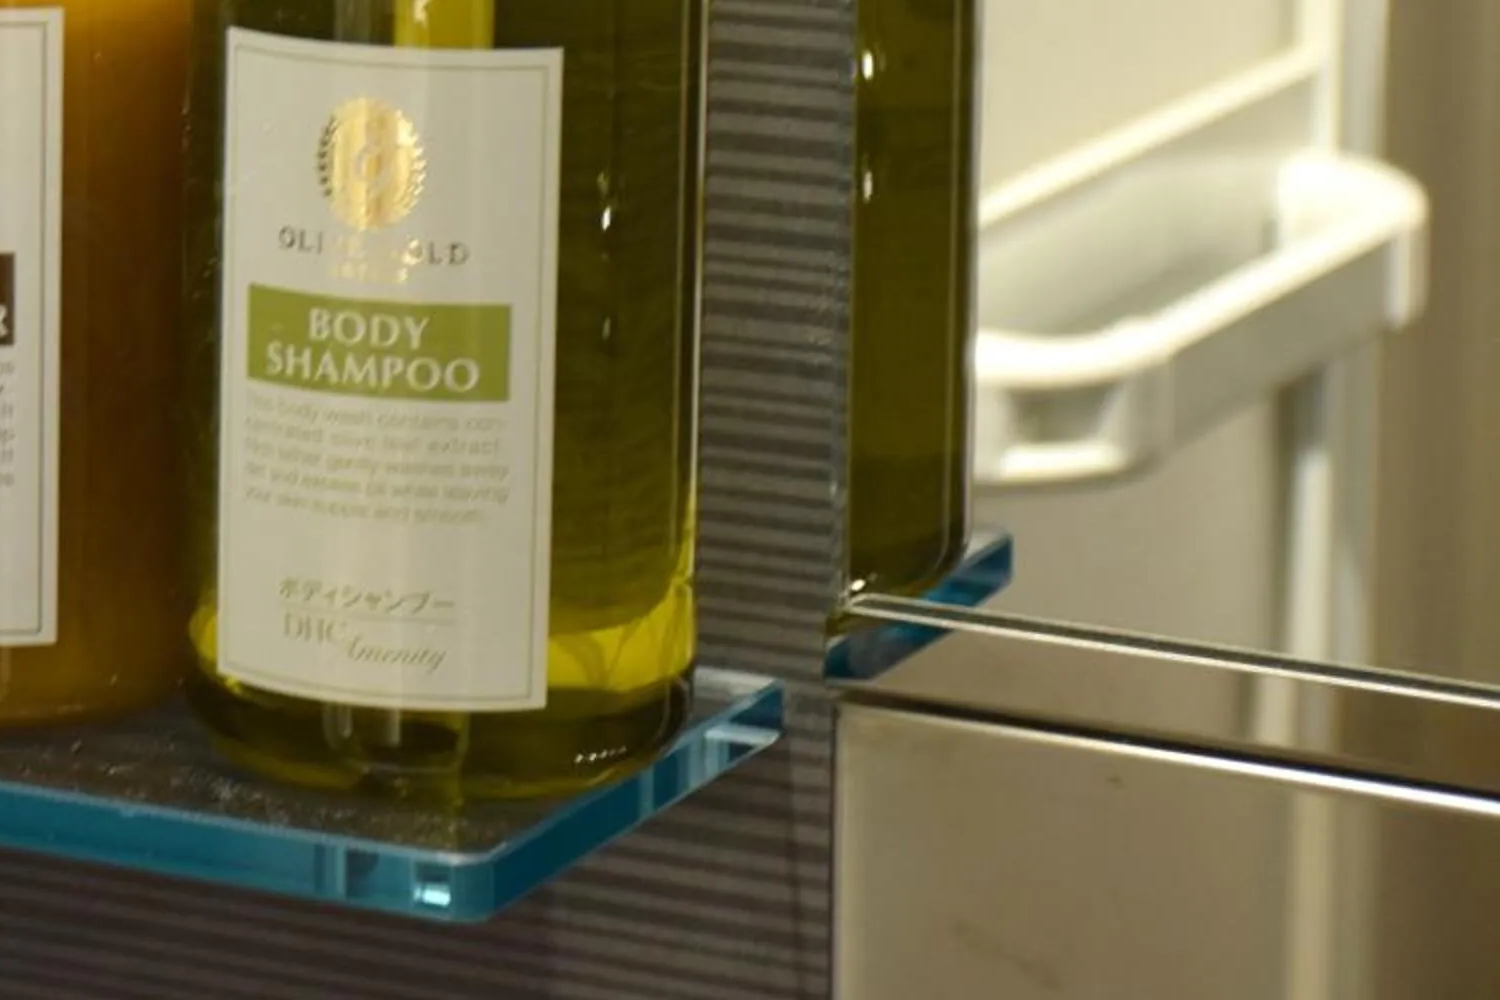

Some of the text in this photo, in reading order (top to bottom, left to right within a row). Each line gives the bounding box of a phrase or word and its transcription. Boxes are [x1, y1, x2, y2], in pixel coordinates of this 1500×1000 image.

[278, 225, 470, 266] OLI OLD
[309, 307, 431, 350] BODY
[265, 340, 481, 394] SHAMPOO
[279, 577, 457, 615] ボディシャンプー
[283, 611, 448, 675] DHC Amenity
